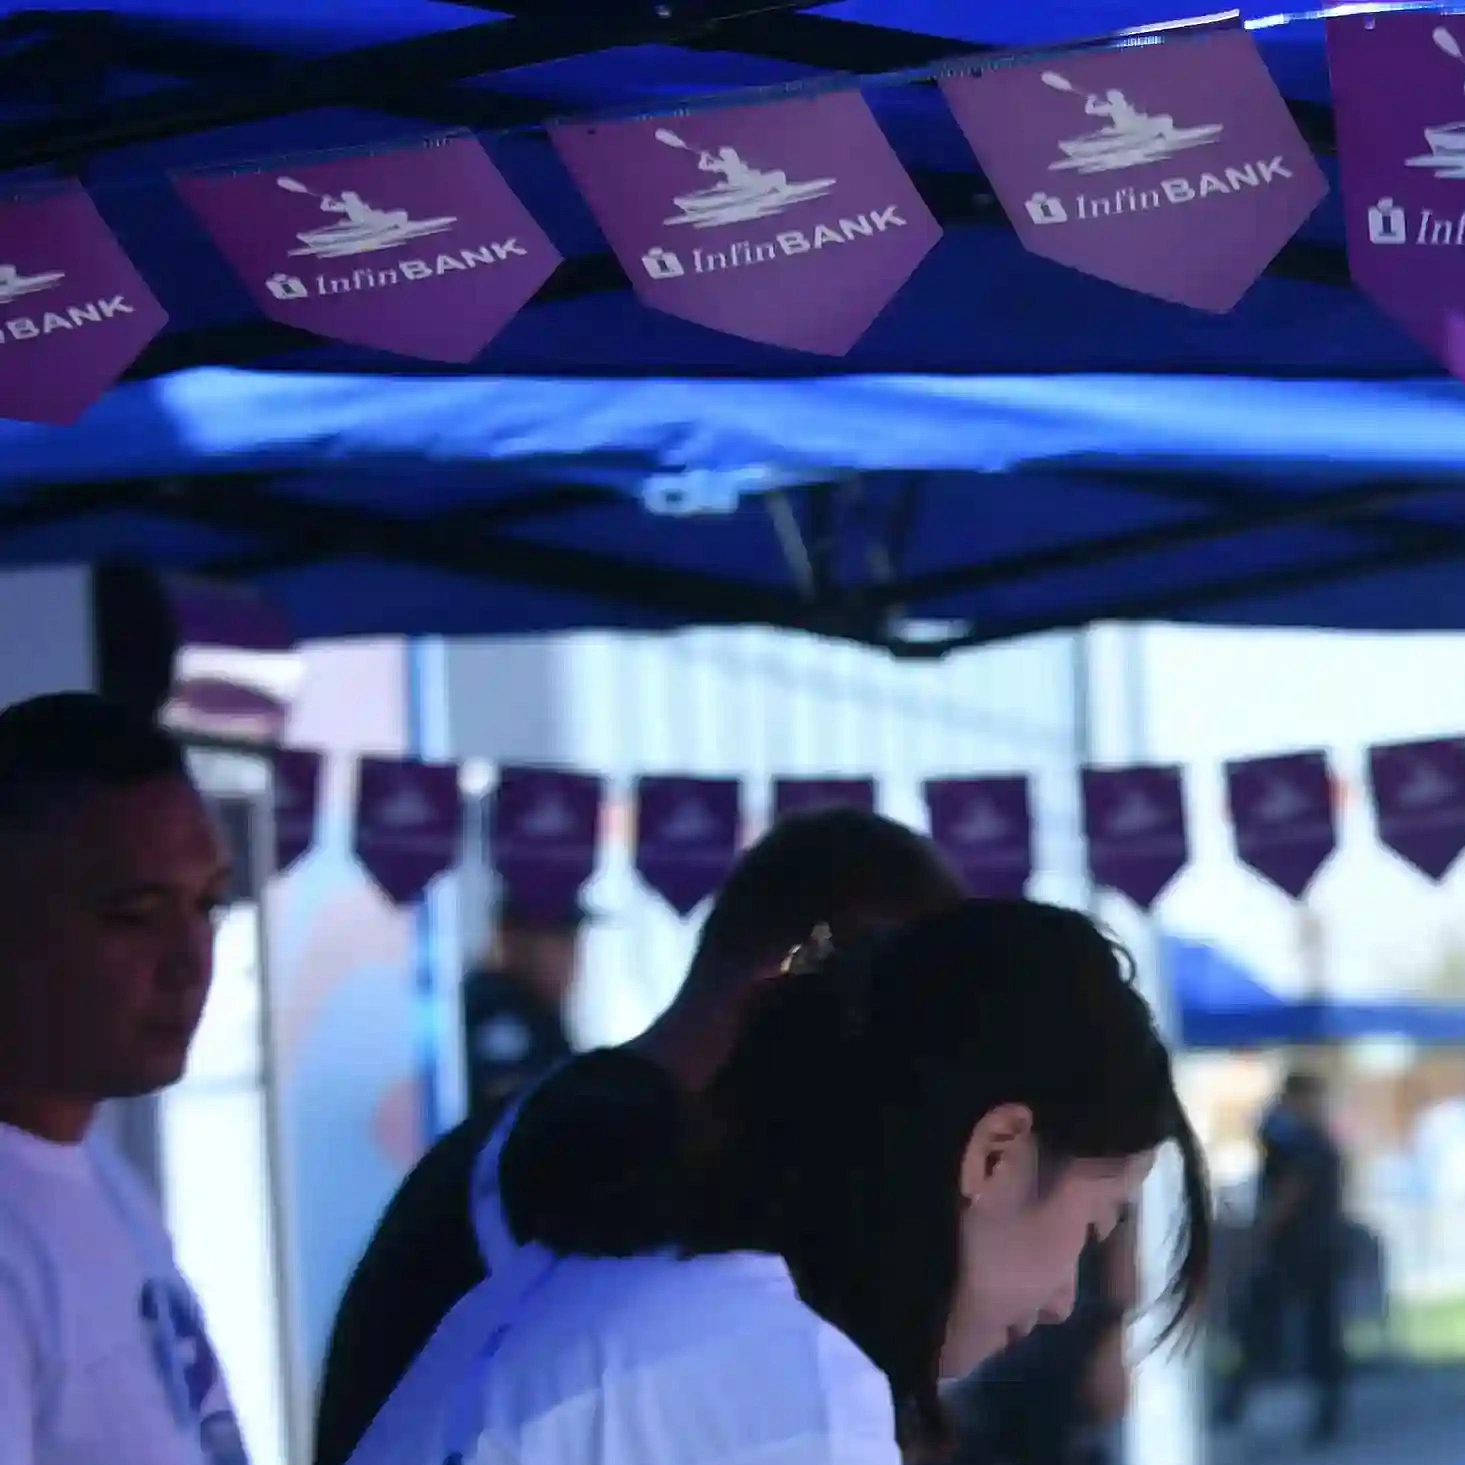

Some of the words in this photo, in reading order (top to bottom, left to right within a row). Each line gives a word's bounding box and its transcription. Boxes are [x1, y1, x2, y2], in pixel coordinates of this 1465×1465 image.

[1076, 155, 1293, 219] InfinBANK
[316, 238, 528, 296] InfinBANK
[693, 204, 907, 273] InfinBANK
